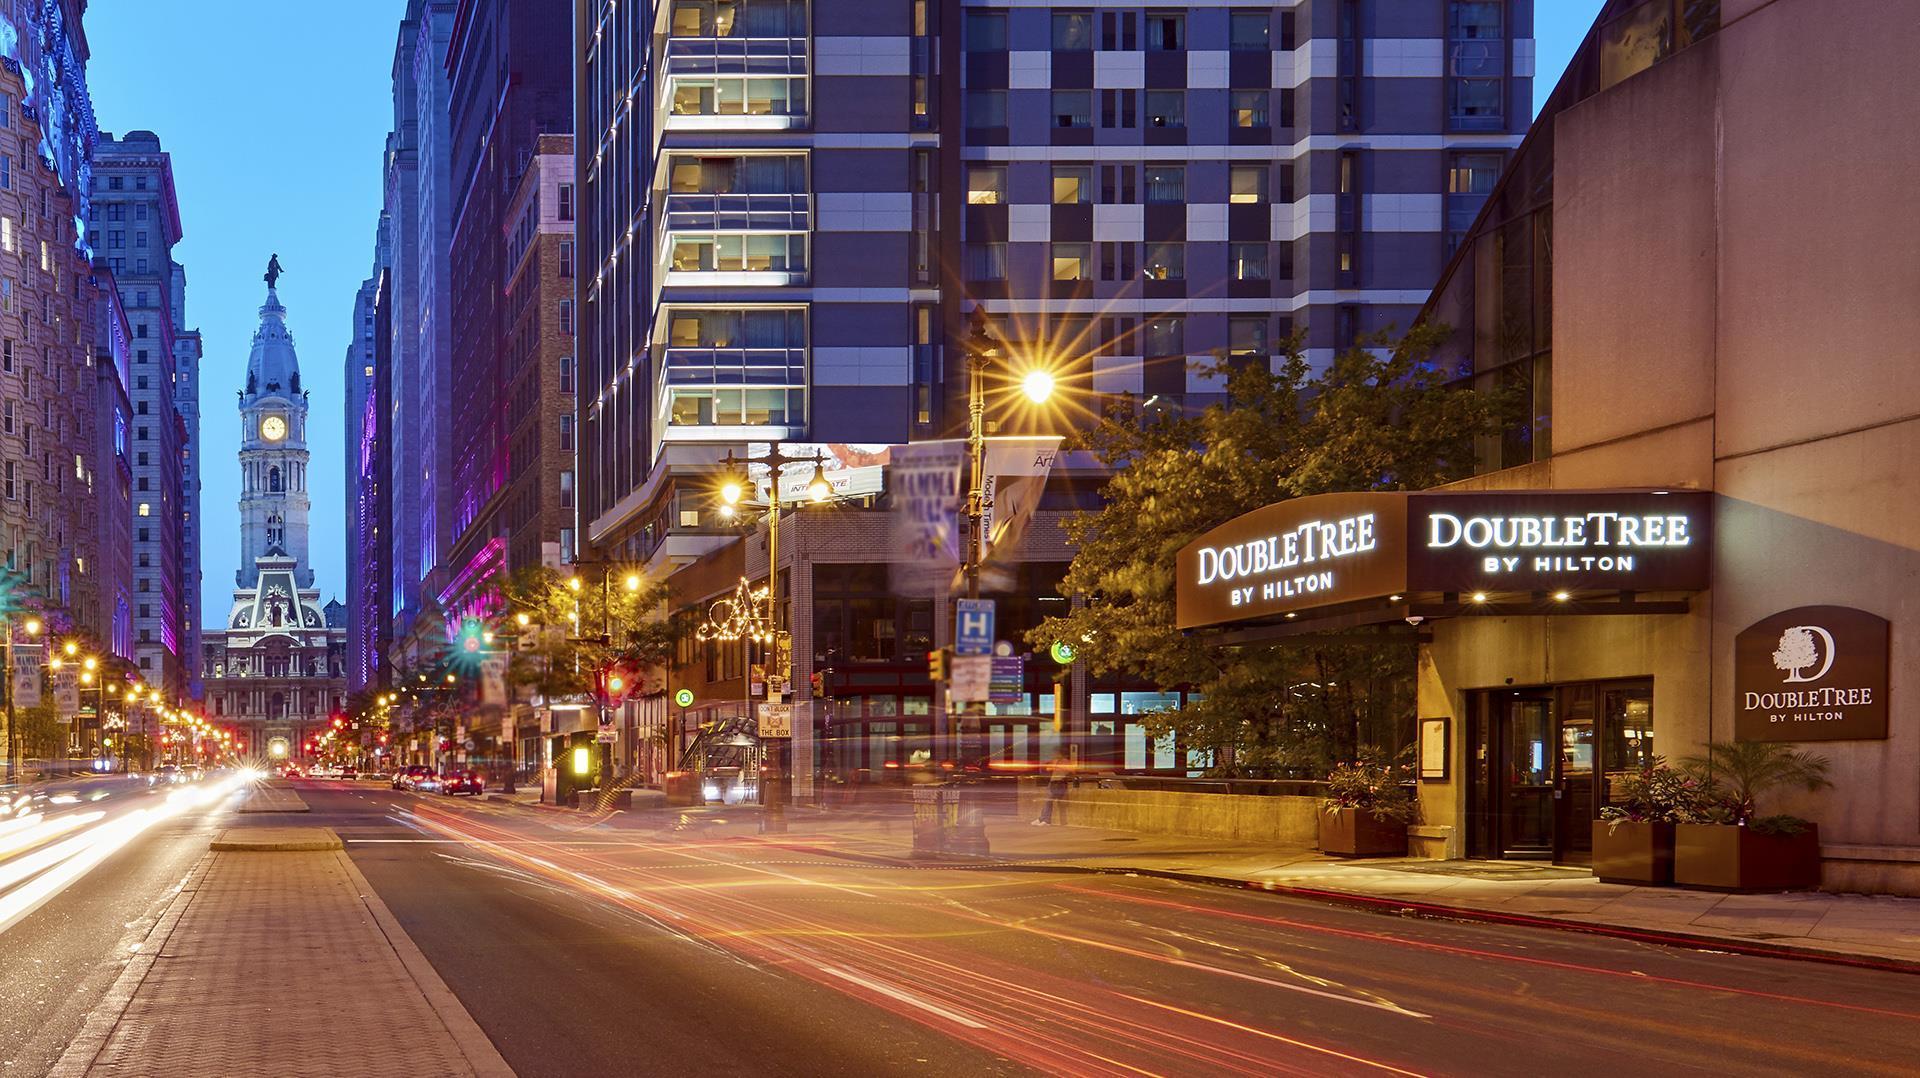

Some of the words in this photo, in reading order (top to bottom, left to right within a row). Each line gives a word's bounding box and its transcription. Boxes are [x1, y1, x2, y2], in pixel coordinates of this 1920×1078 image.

[983, 512, 992, 540] Times
[1428, 512, 1690, 548] DOUBLETREE
[1198, 513, 1376, 585] DOUBLETREE
[1484, 556, 1519, 573] BY
[1535, 556, 1633, 572] HILTON
[1231, 586, 1254, 606] BY
[1263, 571, 1332, 600] HILTON
[963, 612, 987, 637] H
[1744, 687, 1873, 710] DOUBLETREE
[1770, 714, 1786, 723] BY
[1794, 711, 1843, 722] HILTON
